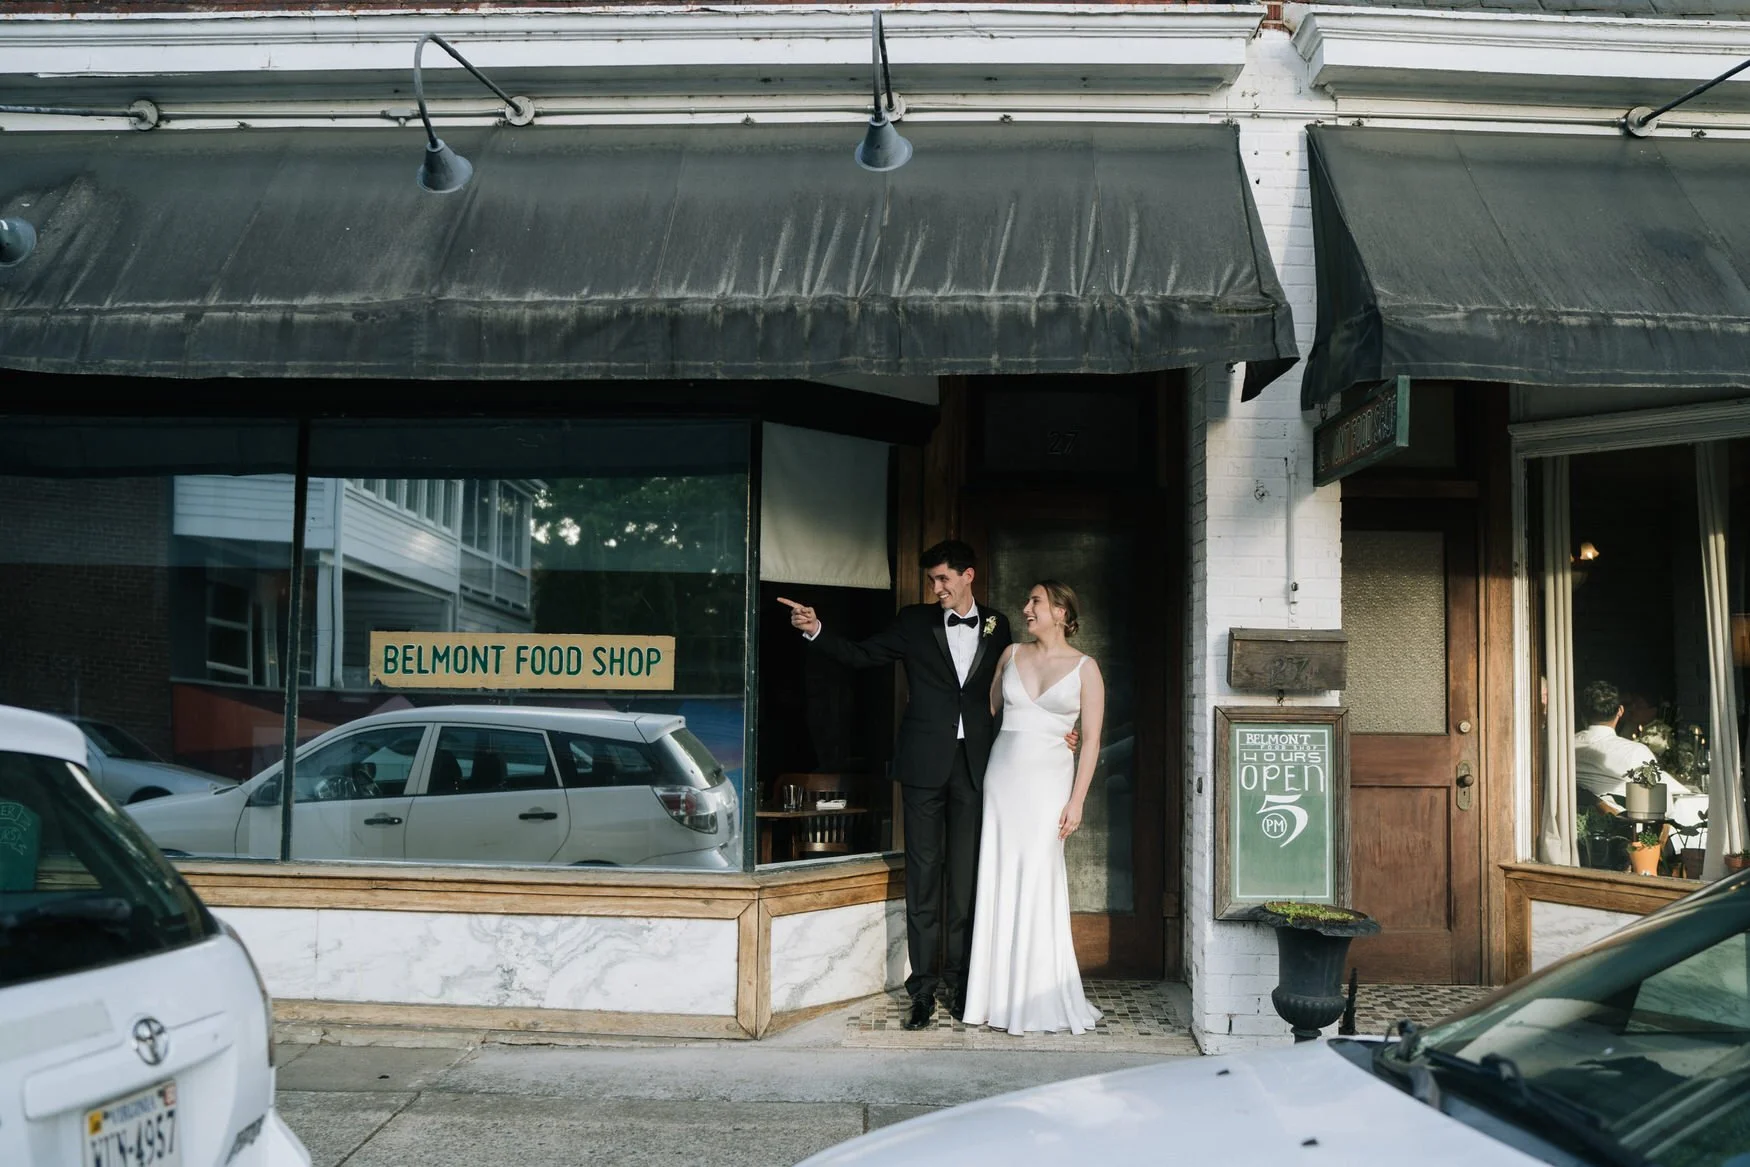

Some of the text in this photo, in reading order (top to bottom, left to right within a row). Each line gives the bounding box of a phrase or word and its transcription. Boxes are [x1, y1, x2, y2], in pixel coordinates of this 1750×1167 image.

[1047, 431, 1078, 456] 27
[1351, 409, 1373, 456] FOOD
[383, 644, 662, 677] BELMONT FOOD SHOP
[1246, 733, 1311, 745] BELMONT
[1243, 752, 1321, 763] HOURS
[1241, 764, 1324, 792] OPEN
[1256, 794, 1308, 848] 5 PM
